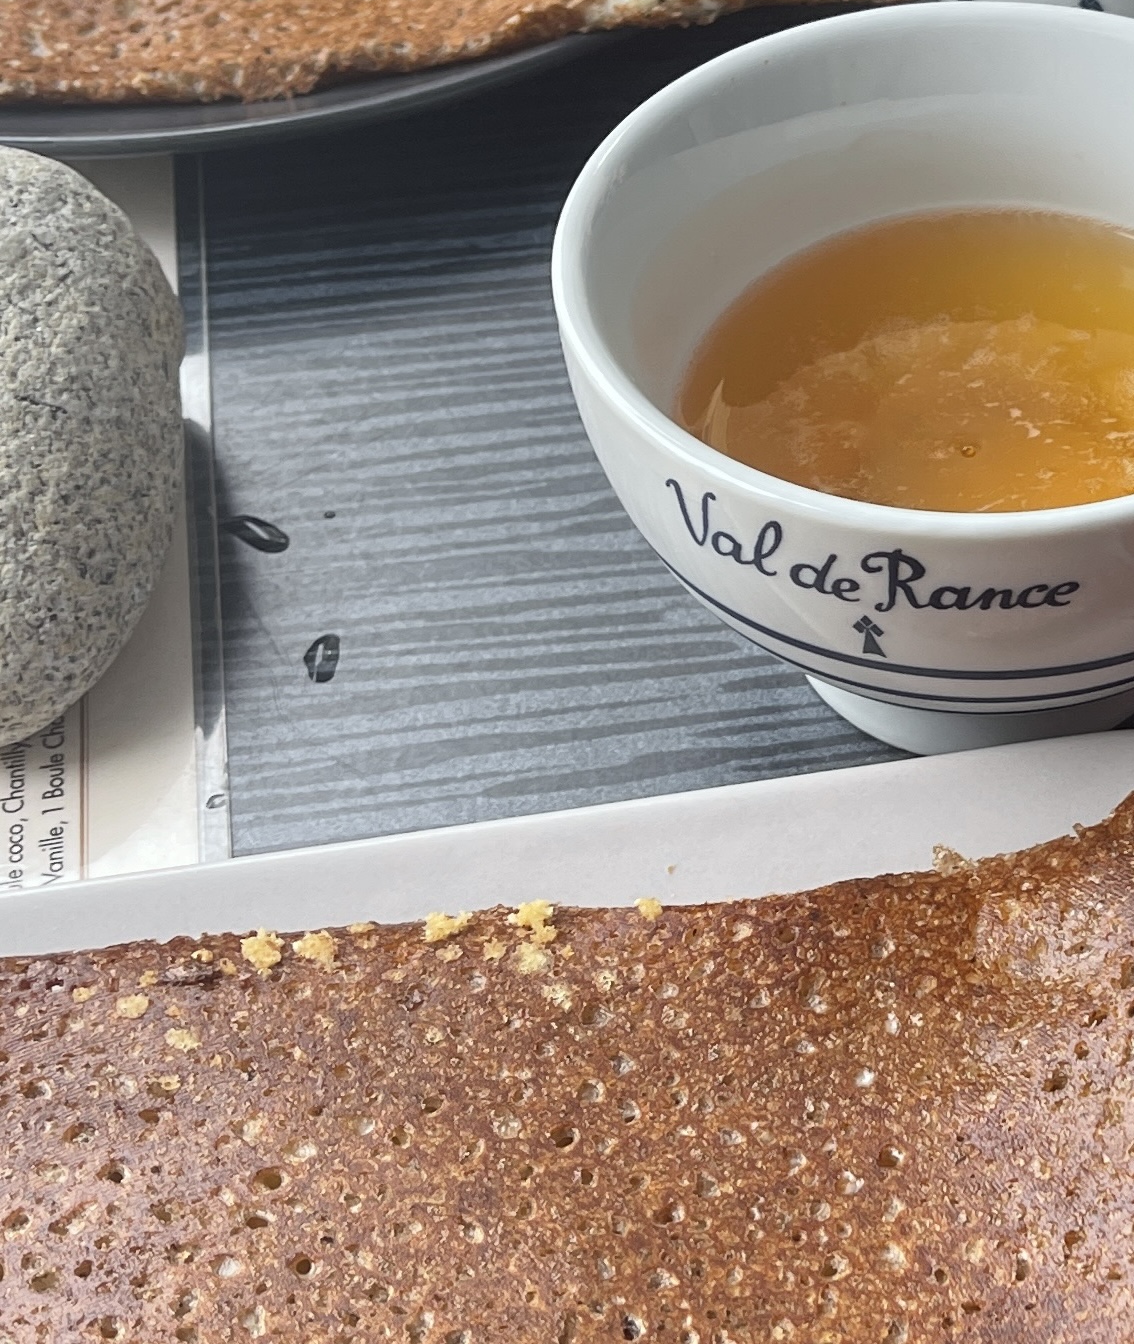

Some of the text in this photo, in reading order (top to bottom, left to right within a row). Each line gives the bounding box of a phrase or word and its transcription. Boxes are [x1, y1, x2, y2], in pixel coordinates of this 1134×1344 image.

[664, 478, 1081, 613] Val de Rance
[38, 753, 65, 800] Boule
[9, 818, 29, 864] coco,
[38, 820, 69, 886] Vanille,
